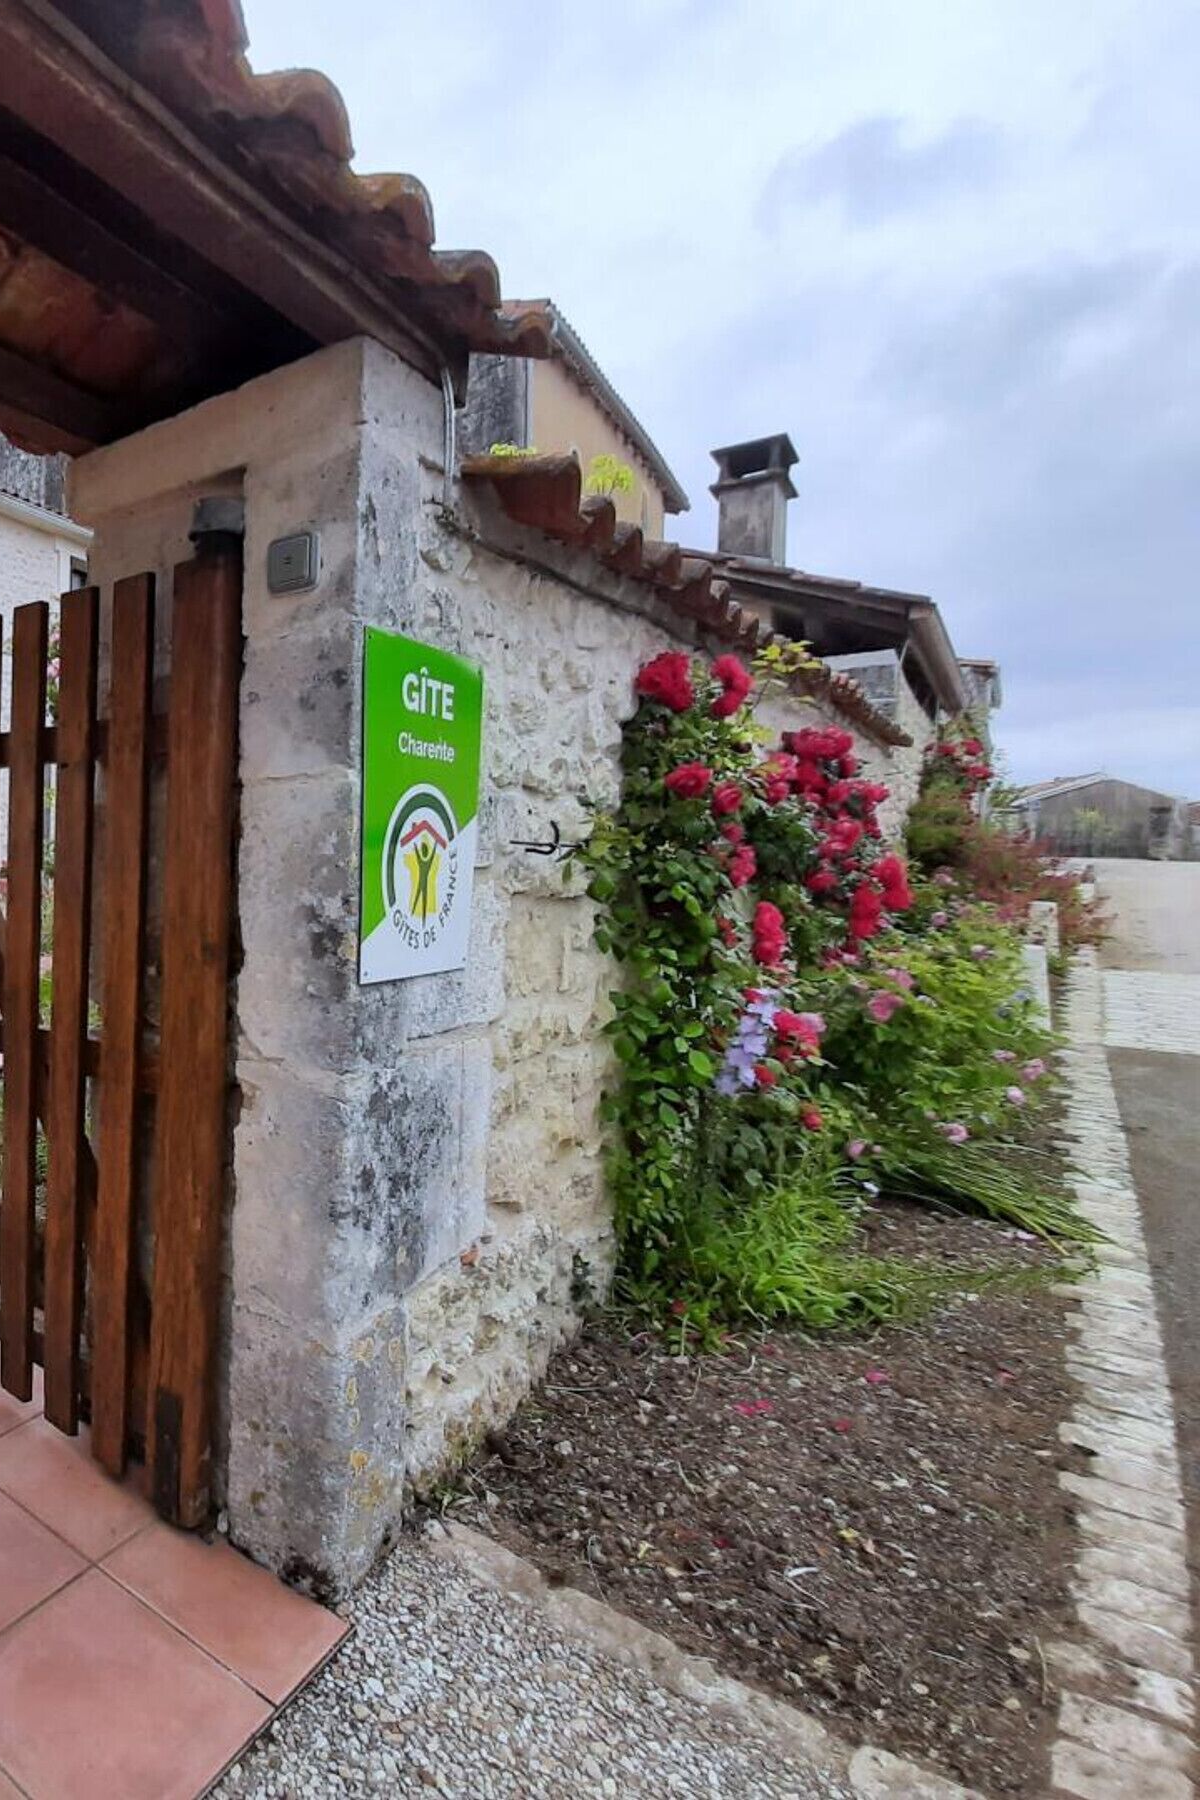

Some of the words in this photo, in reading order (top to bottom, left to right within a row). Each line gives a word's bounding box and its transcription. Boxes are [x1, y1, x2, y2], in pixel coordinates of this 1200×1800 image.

[401, 667, 455, 721] GÎTE
[398, 731, 455, 763] Charente
[423, 926, 437, 948] DE
